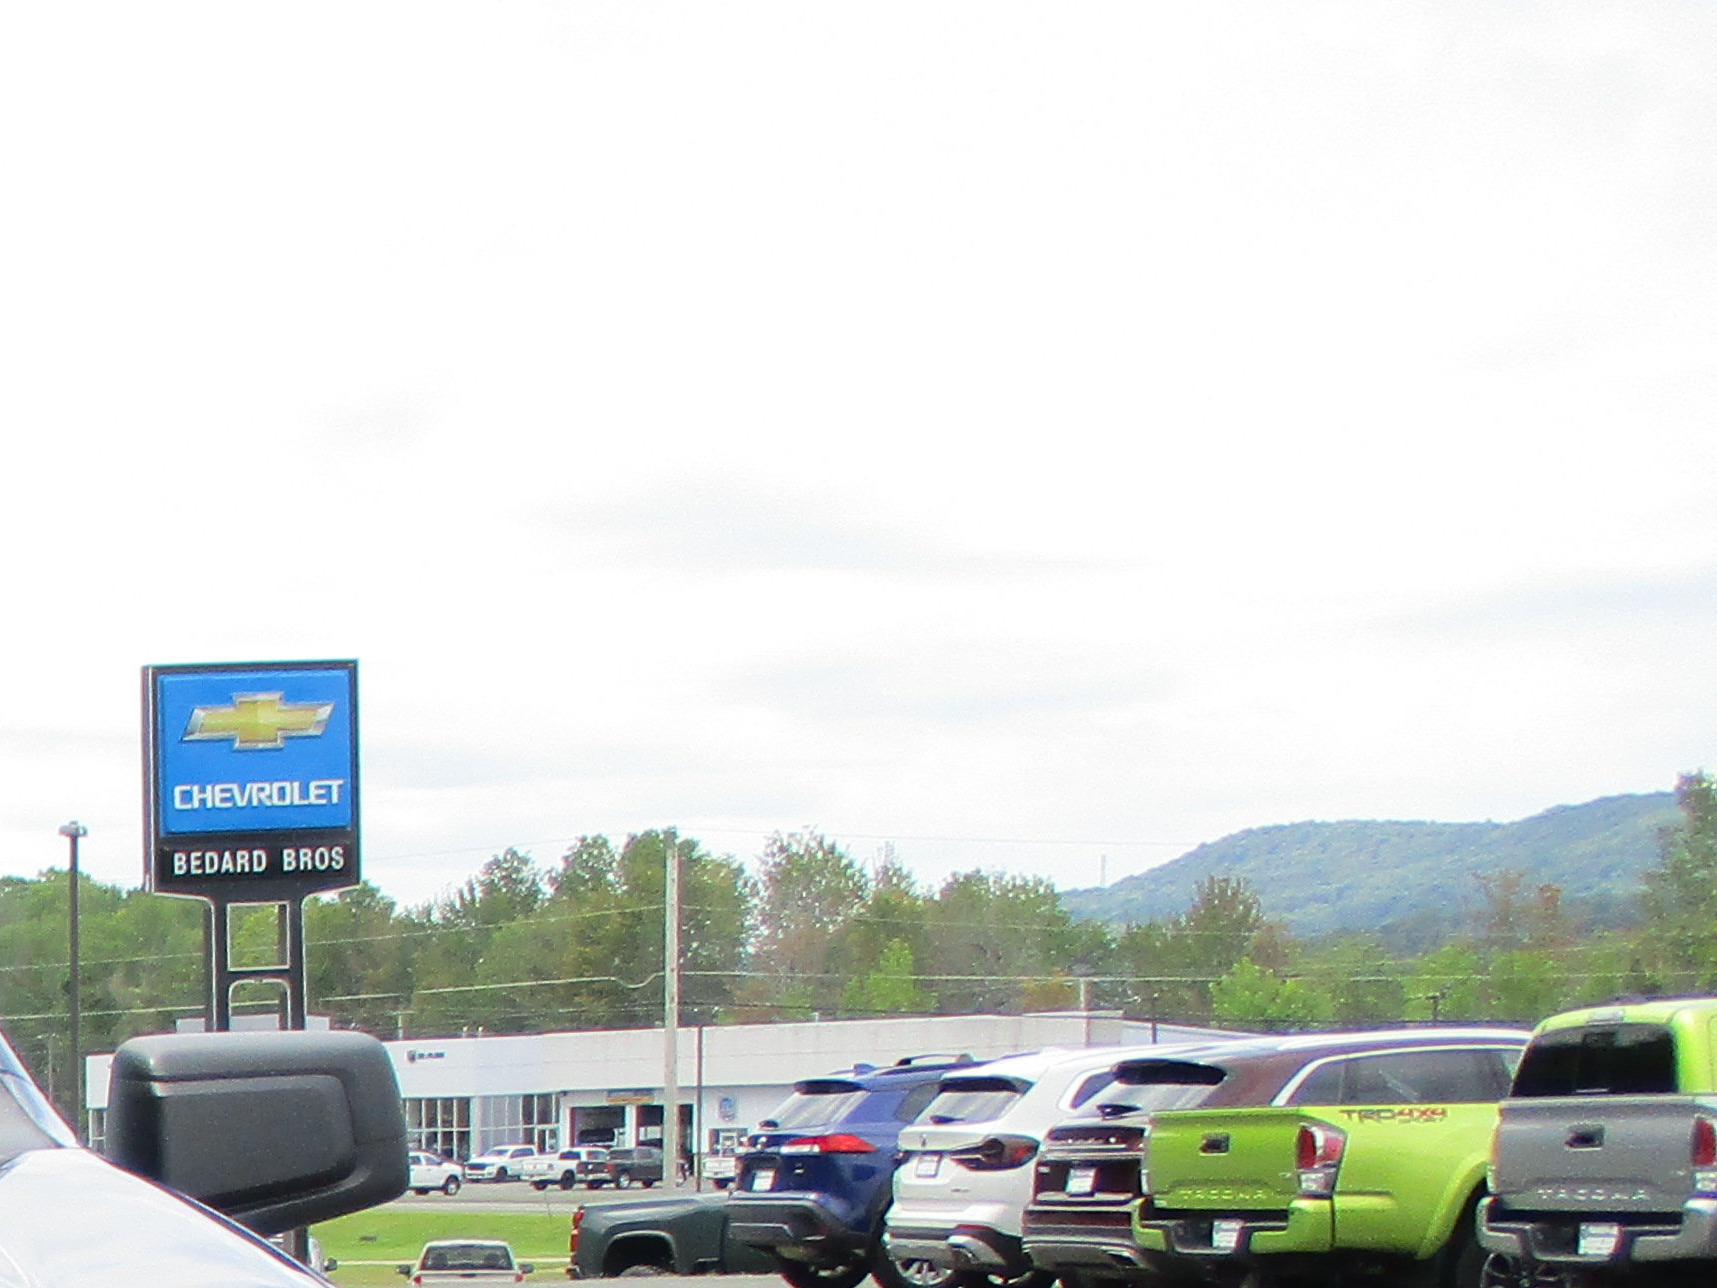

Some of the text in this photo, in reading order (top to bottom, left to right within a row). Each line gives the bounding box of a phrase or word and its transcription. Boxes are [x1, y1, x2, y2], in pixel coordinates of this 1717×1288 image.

[173, 779, 344, 811] CHEVROLET
[173, 846, 346, 876] BEDARD BROS
